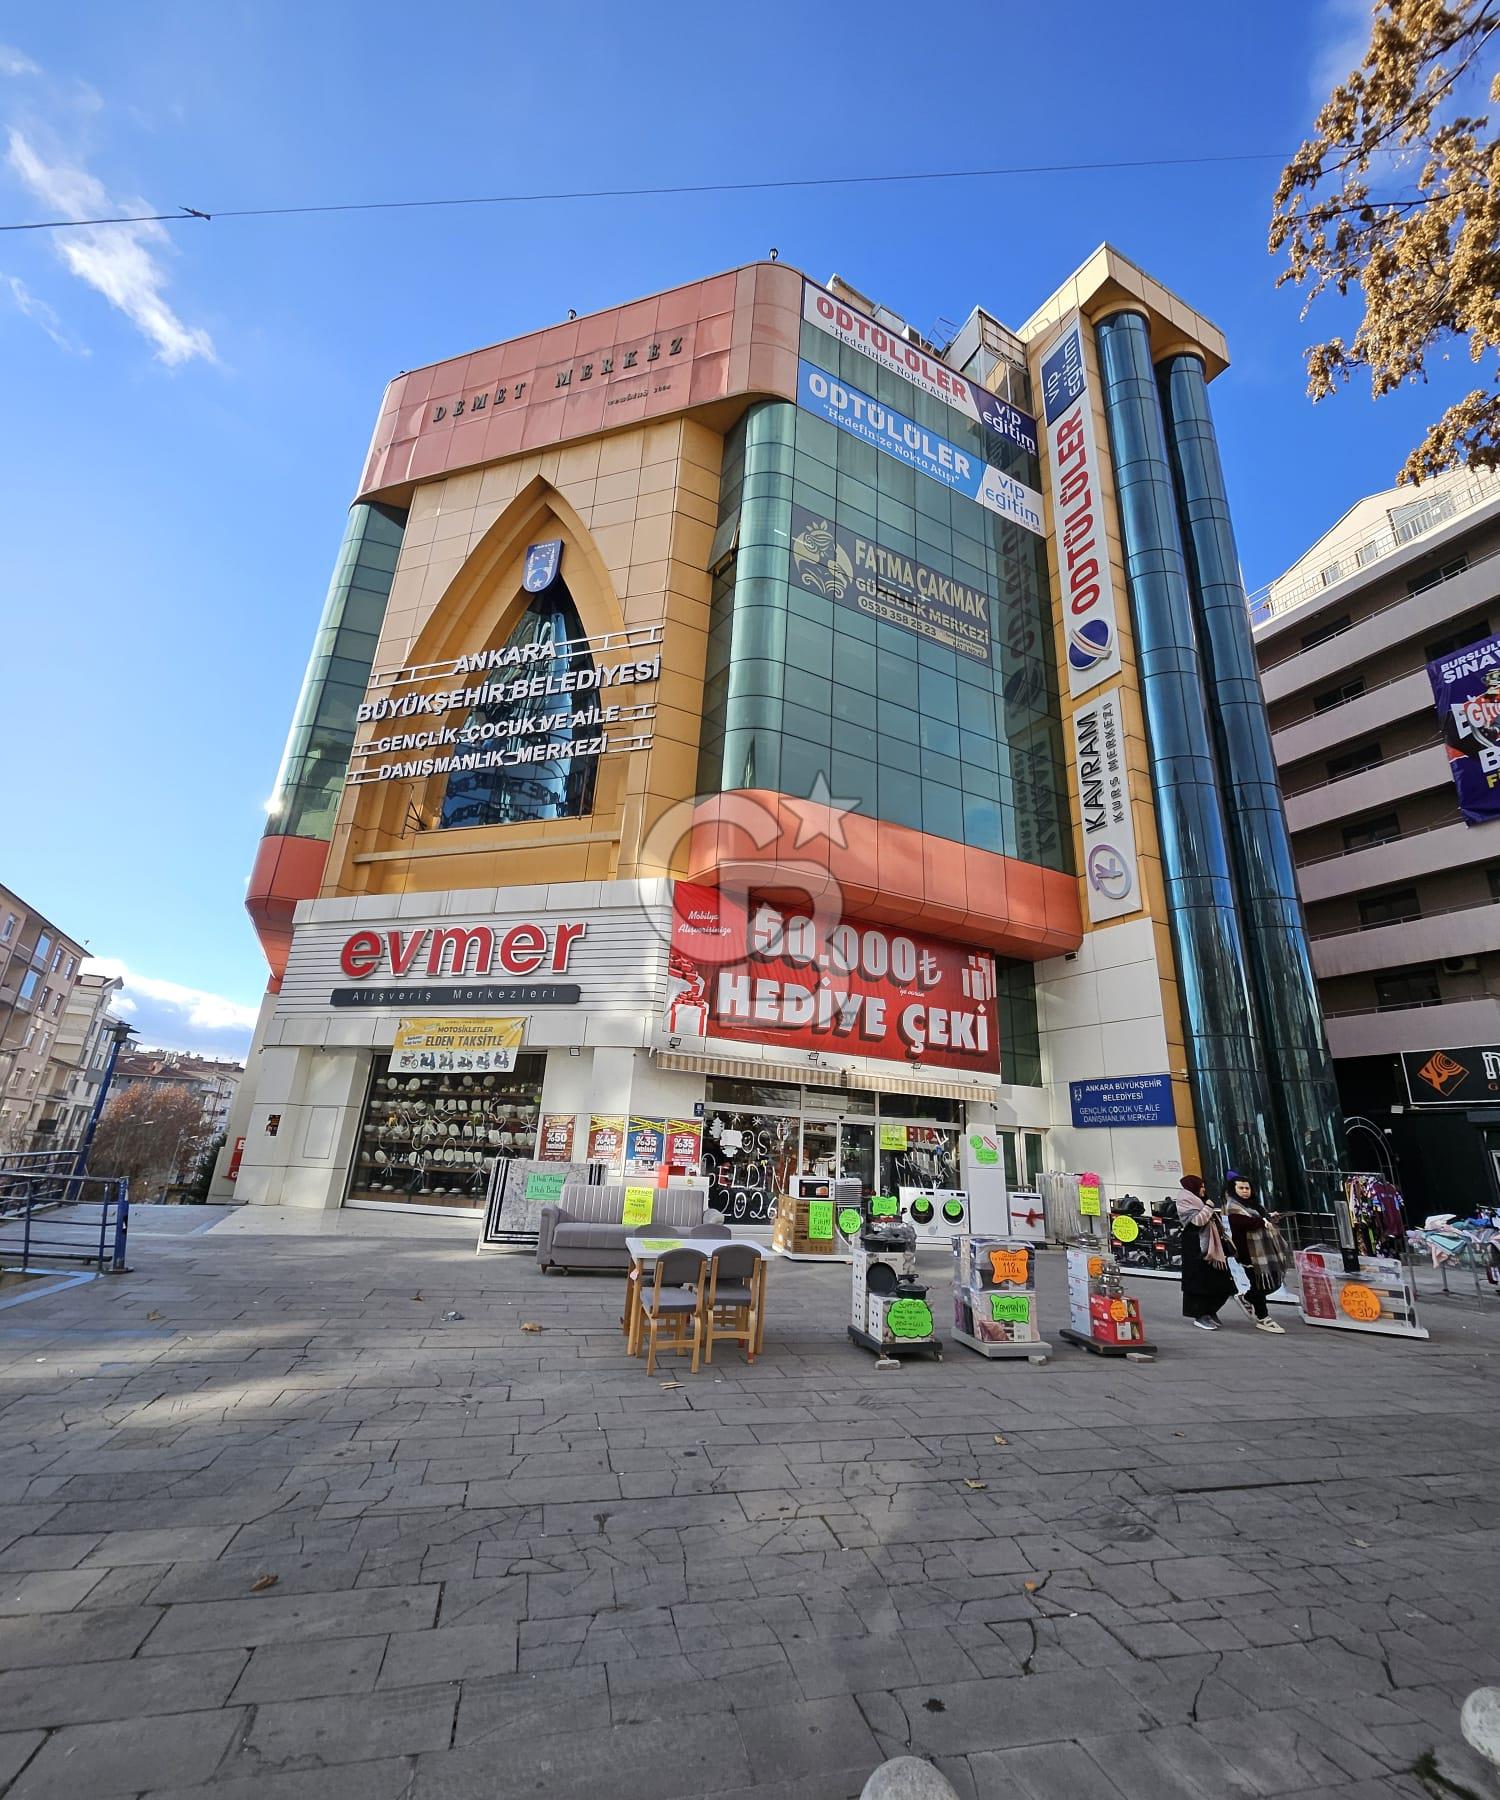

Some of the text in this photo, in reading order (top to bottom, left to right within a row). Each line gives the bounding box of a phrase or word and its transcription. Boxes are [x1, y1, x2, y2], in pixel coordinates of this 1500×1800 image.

[816, 296, 967, 402] ODTÜLÜLER
[432, 336, 683, 423] DEMET MERKEZ
[897, 365, 927, 389] Nokta
[808, 372, 971, 480] ODTÜLÜLER
[895, 443, 929, 469] Nokta
[1057, 406, 1101, 615] ODTÜLÜLER
[855, 539, 987, 622] FATMA ÇAKMAK
[856, 577, 926, 618] GÜZELLİK
[929, 608, 989, 645] MERKEZİ
[861, 599, 888, 616] 0539
[890, 611, 909, 625] 358
[453, 641, 558, 675] ANKARA
[356, 654, 661, 723] BÜYÜKŞEHİR BELEDİYESİ
[466, 716, 539, 742] ÇOCUK
[540, 714, 569, 733] VE
[572, 705, 620, 727] AİLE
[379, 733, 607, 781] DANIŞMANLIK MERKEZİ
[1077, 710, 1108, 835] KAVRAM
[1108, 775, 1125, 824] KURS
[341, 923, 587, 980] evmer
[352, 987, 558, 1002] Alışveriş Merkezleri
[718, 972, 988, 1055] HEDİYE ÇEKİ
[425, 1035, 455, 1047] ELDEN
[457, 1033, 505, 1047] TAKSİTLE
[437, 1025, 494, 1034] MOTOSİKLETLER
[1085, 1079, 1162, 1092] ANKARA BÜYÜKŞEHİR
[1102, 1091, 1144, 1102] BELEDİYESİ
[1133, 1104, 1144, 1113] VE
[718, 1189, 778, 1219] 2026
